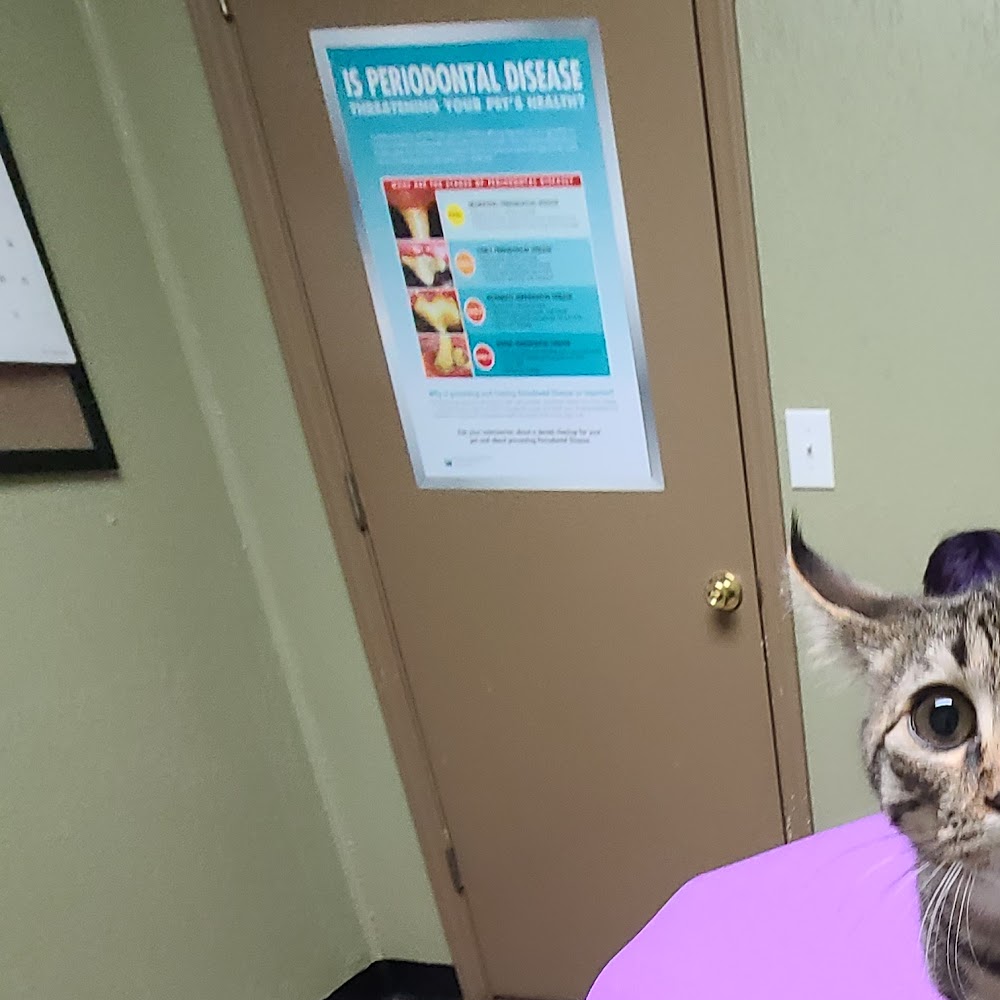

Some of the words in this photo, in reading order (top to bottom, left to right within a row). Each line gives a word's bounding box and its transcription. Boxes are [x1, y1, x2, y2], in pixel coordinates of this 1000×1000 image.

[342, 66, 363, 98] IS
[365, 62, 501, 97] PERIODONTAL
[504, 57, 583, 92] DISEASE
